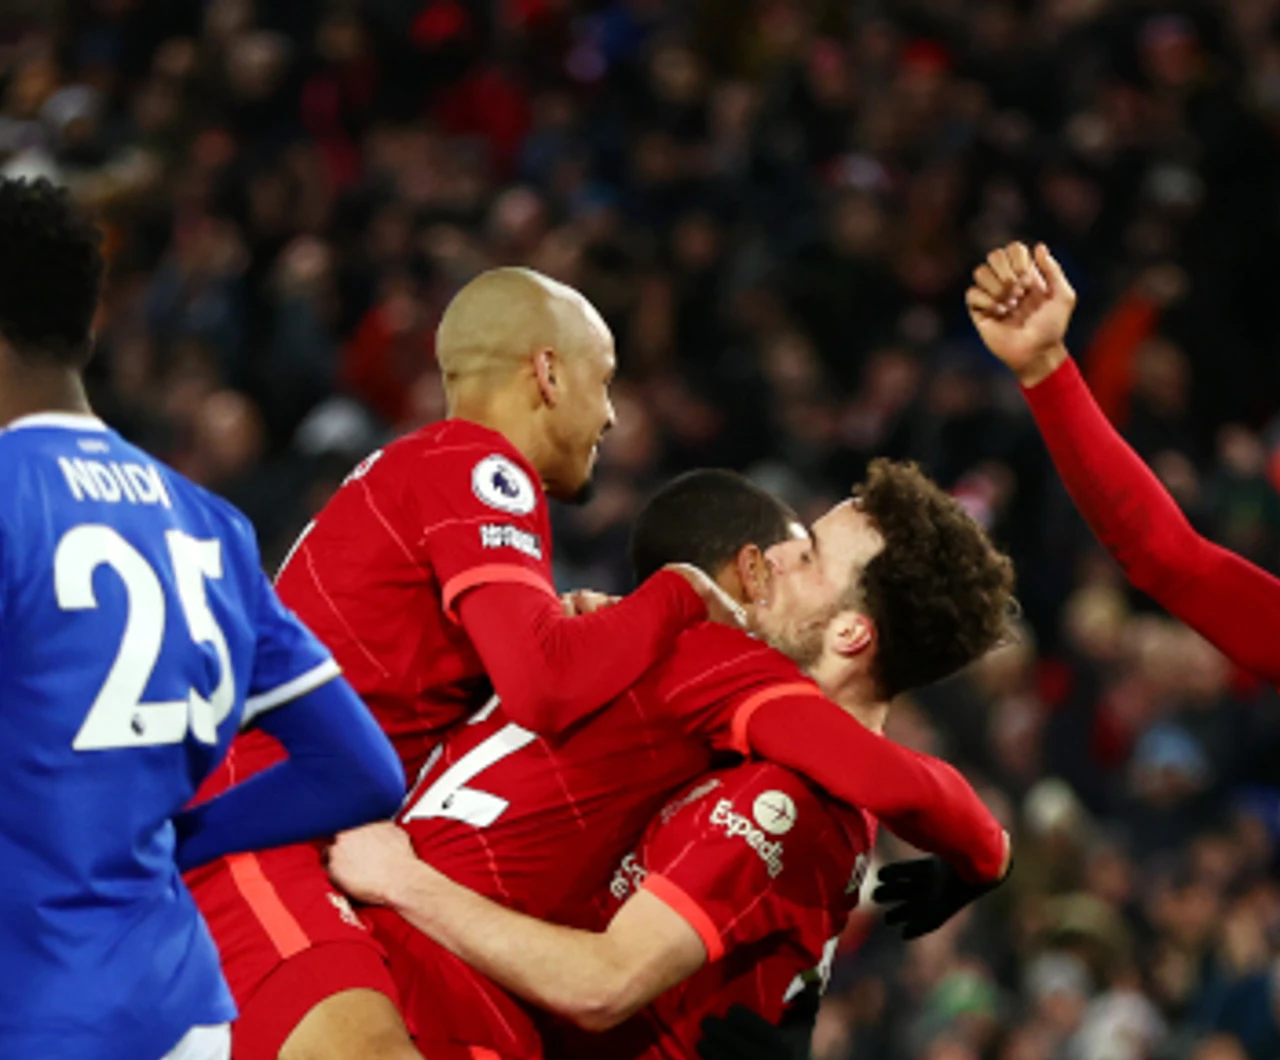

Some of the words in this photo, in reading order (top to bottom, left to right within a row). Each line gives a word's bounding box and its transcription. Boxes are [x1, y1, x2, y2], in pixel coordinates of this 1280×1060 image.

[57, 456, 172, 510] NDIDI
[53, 522, 237, 752] 25
[392, 691, 539, 829] 2
[709, 798, 785, 879] Expedia
